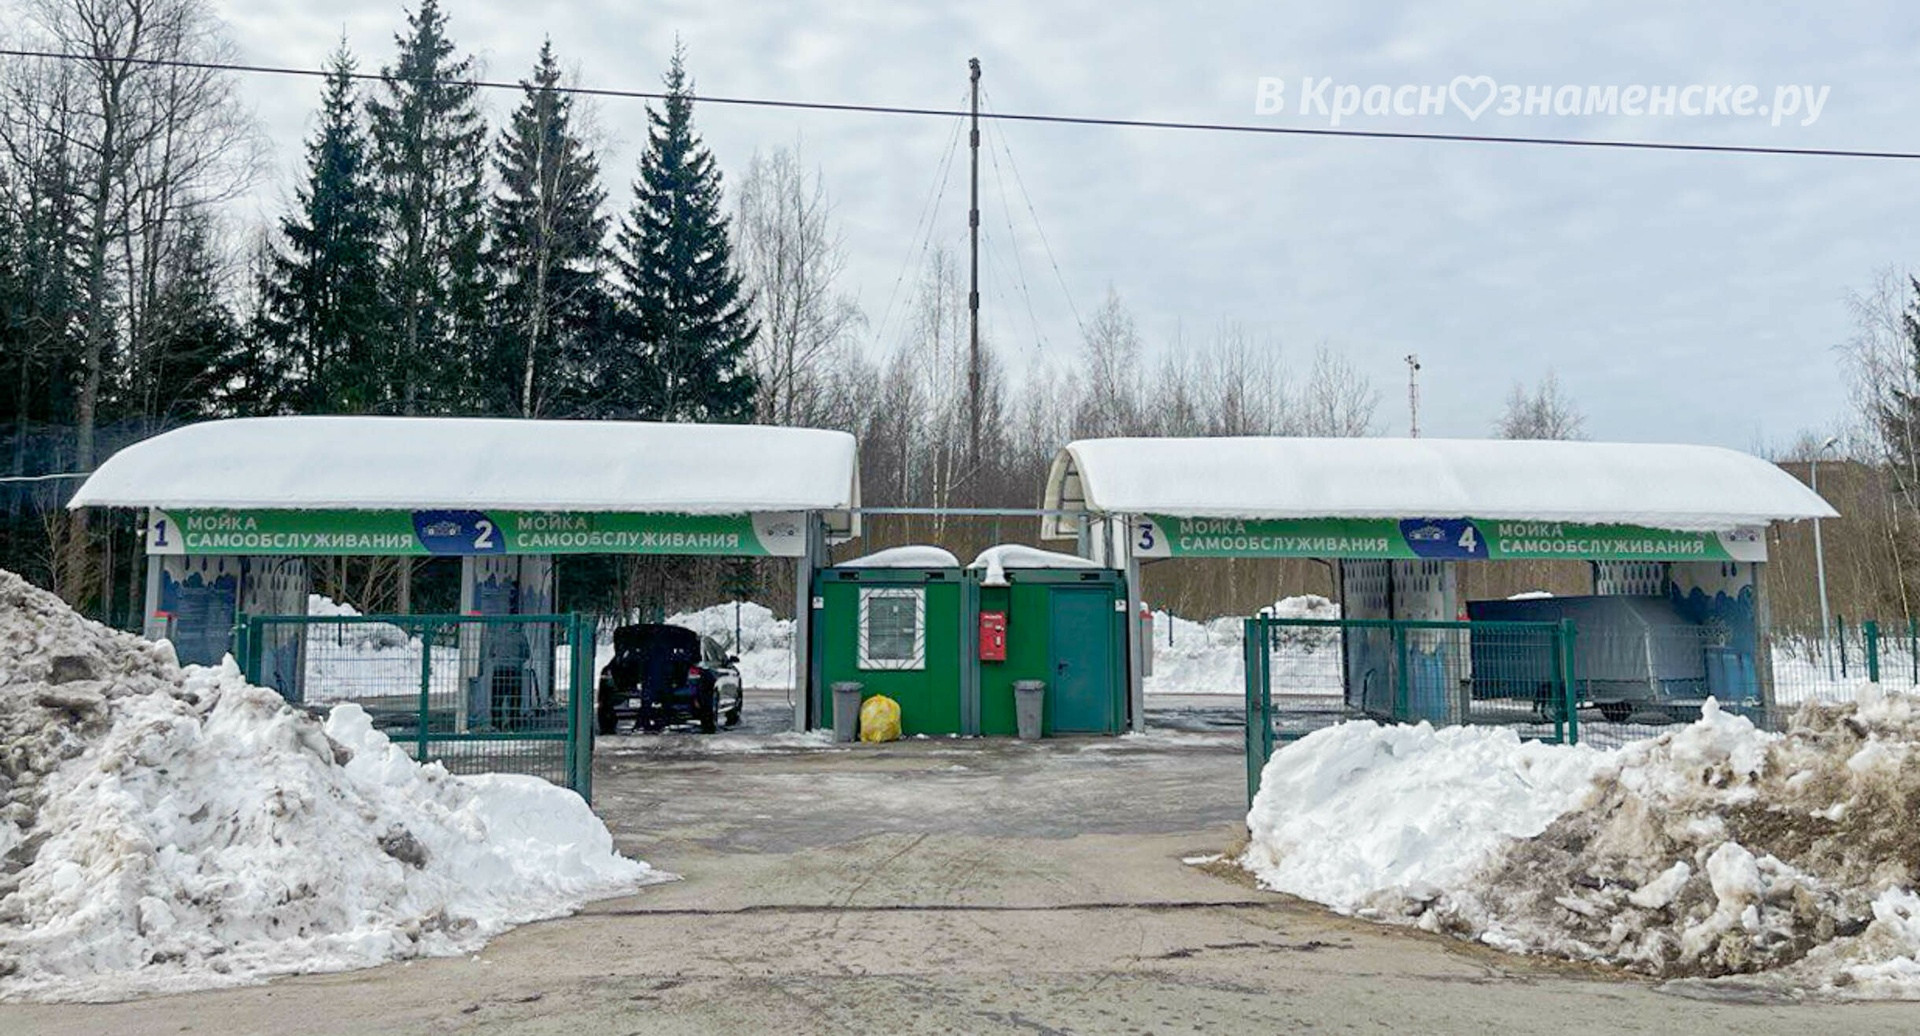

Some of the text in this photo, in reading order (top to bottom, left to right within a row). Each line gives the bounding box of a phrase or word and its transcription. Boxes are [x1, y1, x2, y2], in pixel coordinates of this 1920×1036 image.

[187, 514, 257, 531] МОЙКА
[517, 514, 588, 530] МОЙКА
[154, 520, 168, 546] 1
[186, 533, 413, 549] САМООБСЛУЖИВАНИЯ
[474, 520, 493, 548] 2
[517, 532, 739, 549] САМООБСЛУЖИВАНИЯ
[1138, 524, 1154, 550] 3
[1458, 526, 1477, 553] 4
[1179, 537, 1389, 553] САМООБСЛУЖИВАНИЯ
[1499, 538, 1705, 554] САМООБСЛУЖИВАНИЯ
